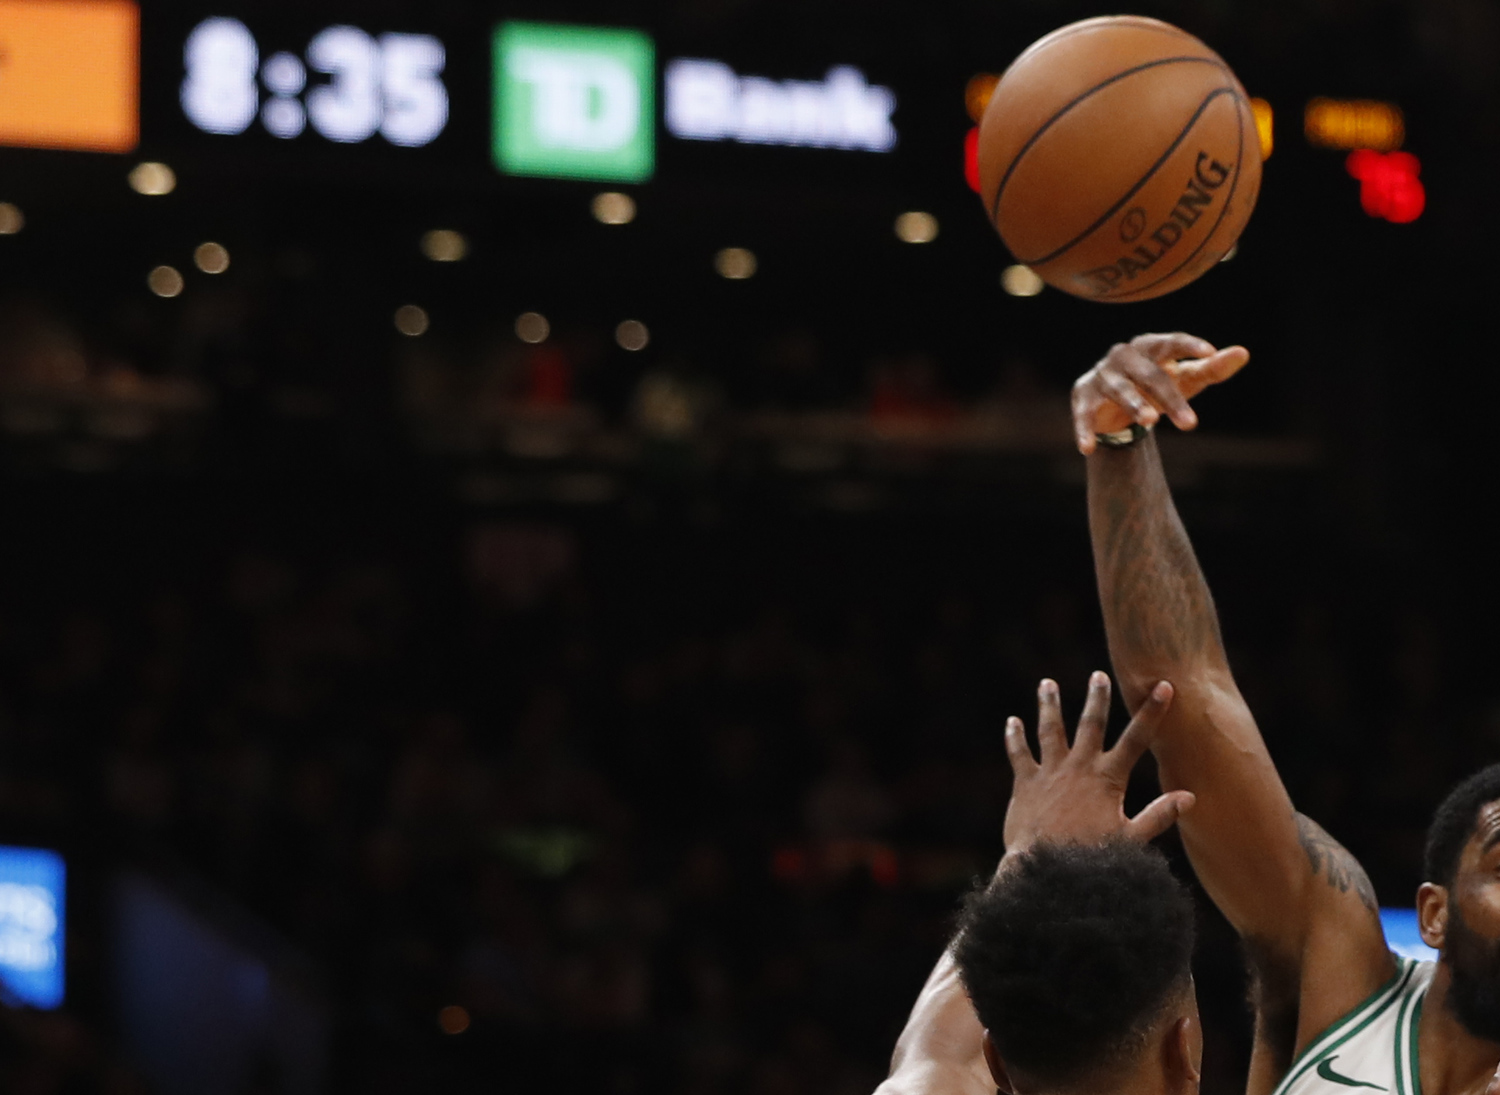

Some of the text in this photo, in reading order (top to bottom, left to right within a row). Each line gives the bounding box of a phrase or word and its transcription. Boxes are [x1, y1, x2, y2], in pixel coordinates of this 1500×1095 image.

[179, 15, 449, 148] 8:35
[505, 46, 641, 150] TD
[664, 57, 897, 153] Bank
